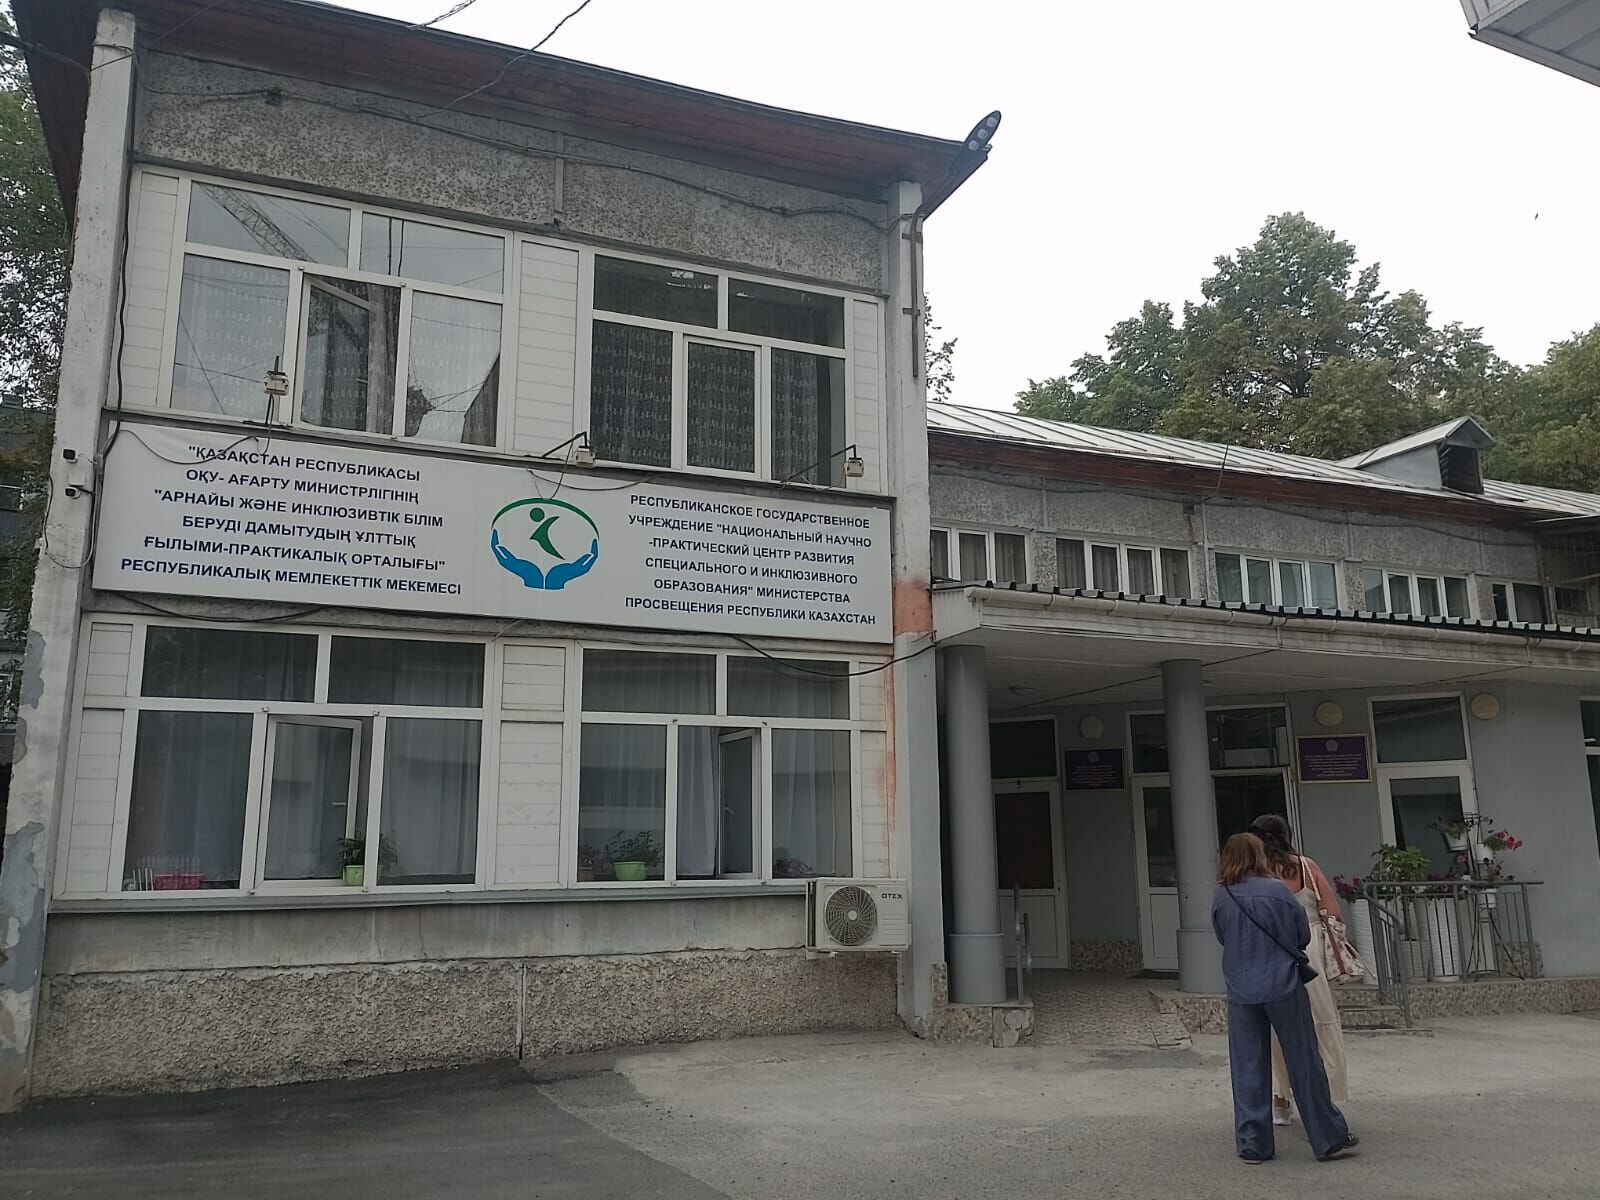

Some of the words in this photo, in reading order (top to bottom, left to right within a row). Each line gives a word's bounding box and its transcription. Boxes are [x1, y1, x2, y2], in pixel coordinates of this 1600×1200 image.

[295, 457, 420, 481] РЕСПУБЛИКАСЫ
[186, 469, 224, 483] ОҚУ-
[228, 474, 290, 490] АҒАРТУ
[294, 480, 419, 504] МИНИСТРЛІГІНІҢ
[154, 489, 234, 507] "АРНАЙЫ
[239, 497, 287, 513] ЖӘНЕ
[291, 502, 400, 523] ИНКЛЮЗИВТІК
[404, 513, 443, 527] БІЛІМ
[630, 495, 753, 517] РЕСПУБЛИКАНСКОЕ
[757, 508, 870, 529] ГОСУДАРСТВЕННОЕ
[183, 516, 241, 533] БЕРУДІ
[245, 521, 351, 543] ДАМЫТУДЫҢ
[355, 531, 416, 548] ҰЛТТЫҚ
[628, 514, 713, 533] УЧРЕЖДЕНИЕ
[716, 523, 823, 543] "НАЦИОНАЛЬНЫЙ
[826, 534, 872, 548] НАУЧНО
[144, 536, 347, 565] ҒЫЛЫМИ-ПРАКТИКАЛЫҚ
[351, 553, 446, 571] ОРТАЛЫҒЫ"
[648, 537, 750, 556] -ПРАКТИЧЕСКИЙ
[753, 547, 791, 559] ЦЕНТР
[794, 551, 854, 565] РАЗВИТИЯ
[121, 558, 271, 583] РЕСПУБЛИКАЛЫҚ
[275, 570, 383, 589] МЕМЛЕКЕТТІК
[386, 579, 461, 595] МЕКЕМЕСІ
[645, 557, 747, 576] СПЕЦИАЛЬНОГО
[750, 566, 758, 577] И
[761, 567, 858, 585] ИНКЛЮЗИВНОГО
[654, 579, 753, 596] ОБРАЗОВАНИЯ"
[756, 587, 850, 603] МИНИСТЕРСТВА
[625, 597, 723, 614] ПРОСВЕЩЕНИЯ
[727, 604, 805, 620] РЕСПУБЛИКИ
[808, 610, 876, 625] КАЗАХСТАН
